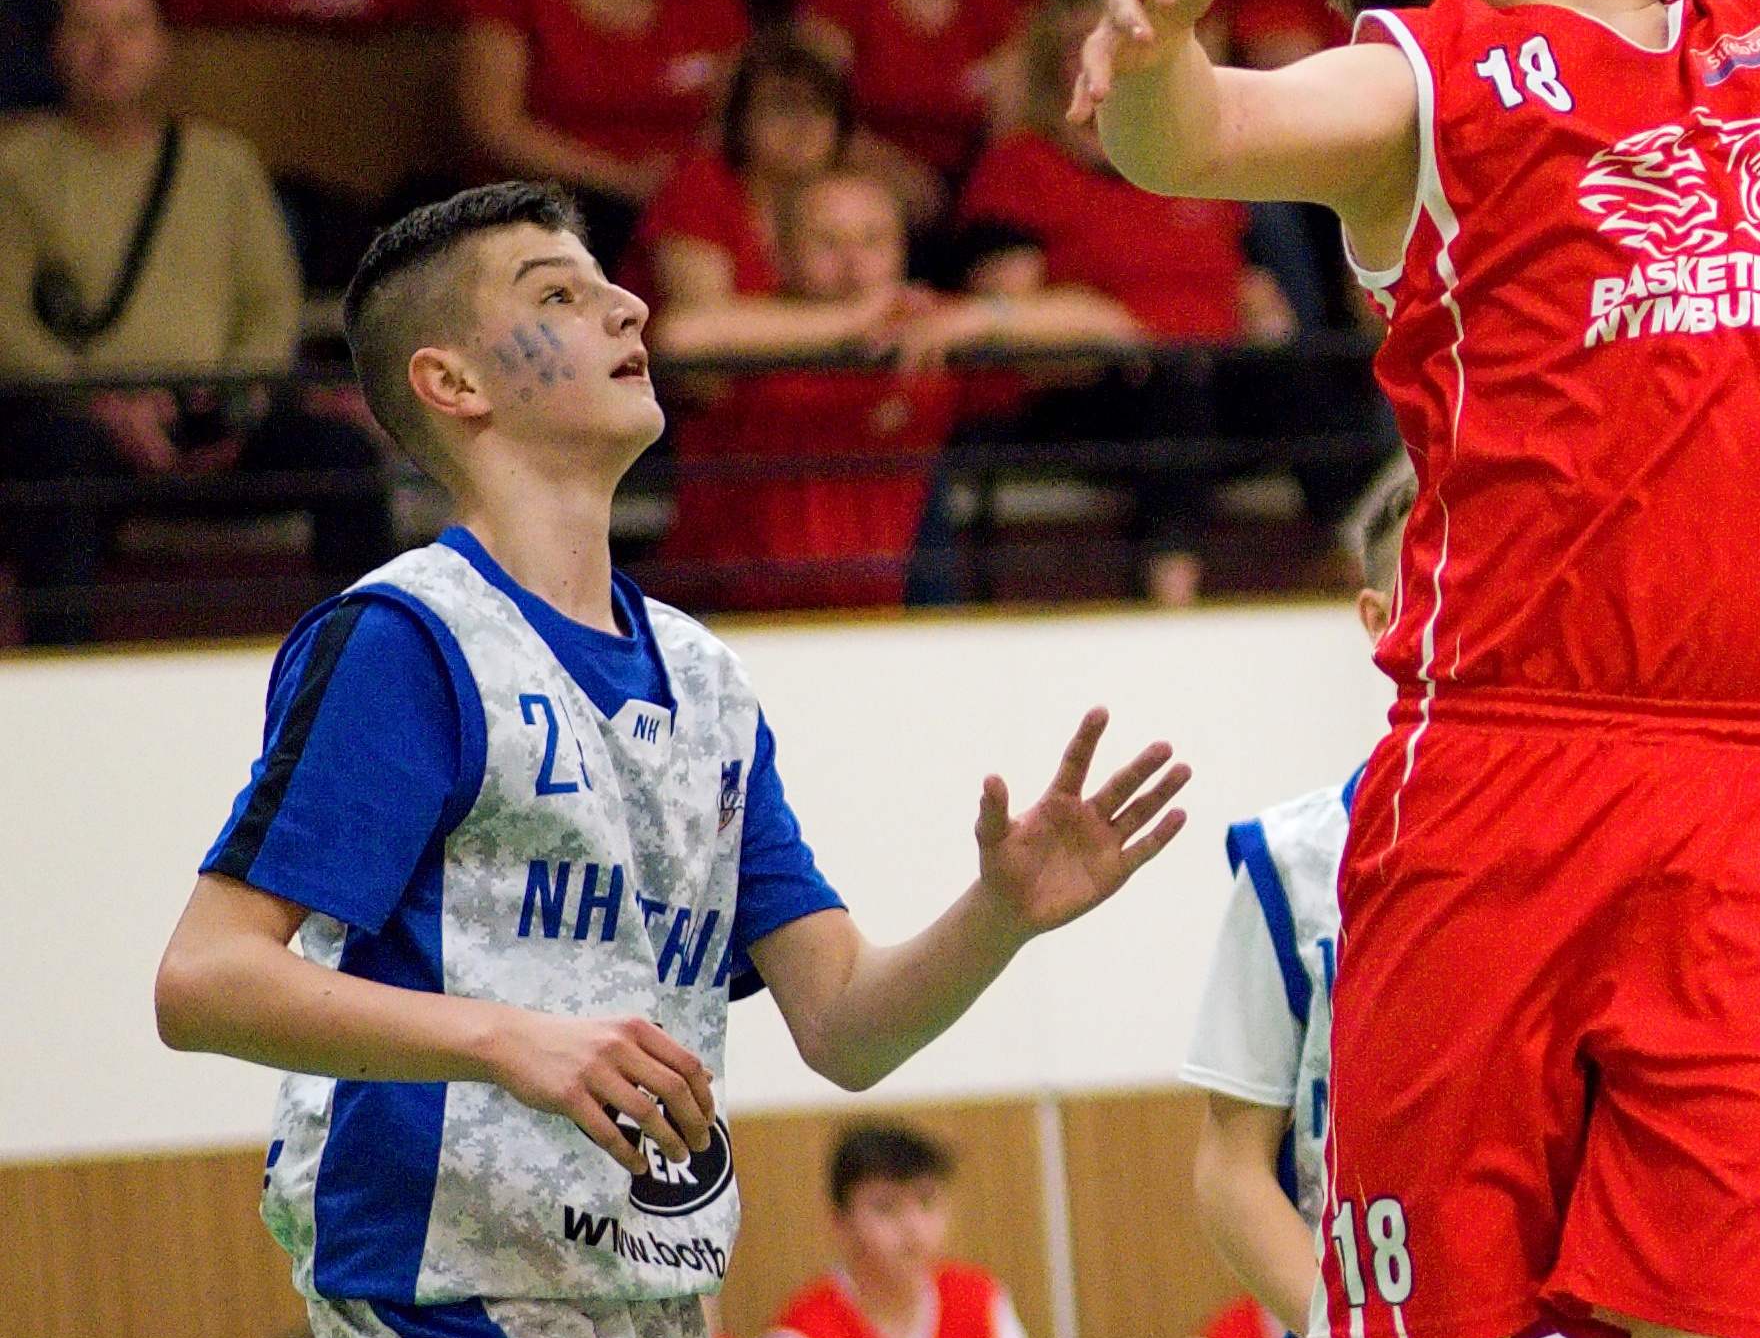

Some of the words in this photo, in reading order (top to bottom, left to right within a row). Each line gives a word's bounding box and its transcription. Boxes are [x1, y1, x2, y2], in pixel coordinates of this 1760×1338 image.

[1474, 33, 1575, 114] 18
[632, 713, 660, 744] NH
[517, 859, 625, 943] NH
[1331, 1196, 1414, 1307] 18
